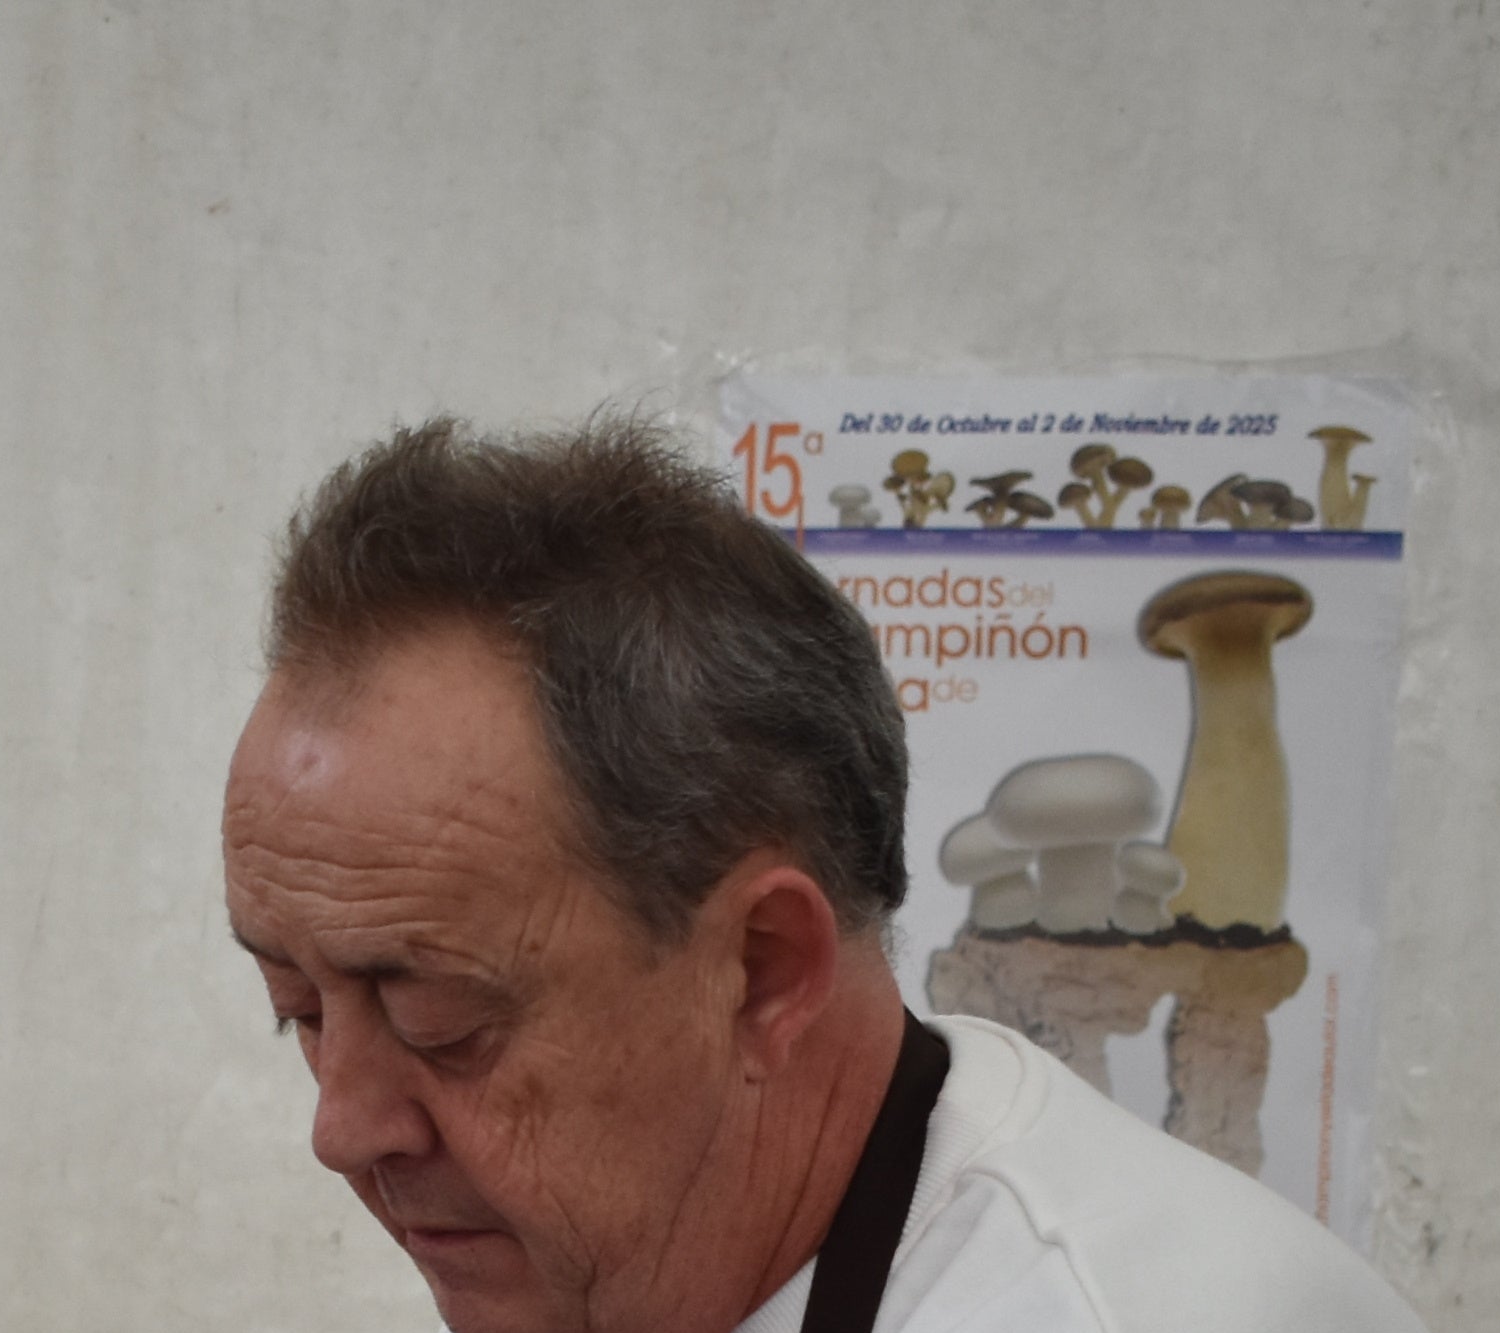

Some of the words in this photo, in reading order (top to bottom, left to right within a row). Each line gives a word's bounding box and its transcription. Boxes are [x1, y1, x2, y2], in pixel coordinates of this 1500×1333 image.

[839, 412, 874, 433] Del
[877, 412, 901, 433] 30
[907, 413, 931, 433] de
[936, 412, 1010, 434] Octubre
[1017, 413, 1037, 433] al
[1043, 413, 1055, 433] 2
[1059, 413, 1083, 434] de
[1090, 412, 1193, 435] Noviembre
[1195, 414, 1220, 436] de
[1225, 414, 1279, 436] 2025
[837, 567, 1005, 608] rnadas
[878, 612, 1089, 669] mpiñón
